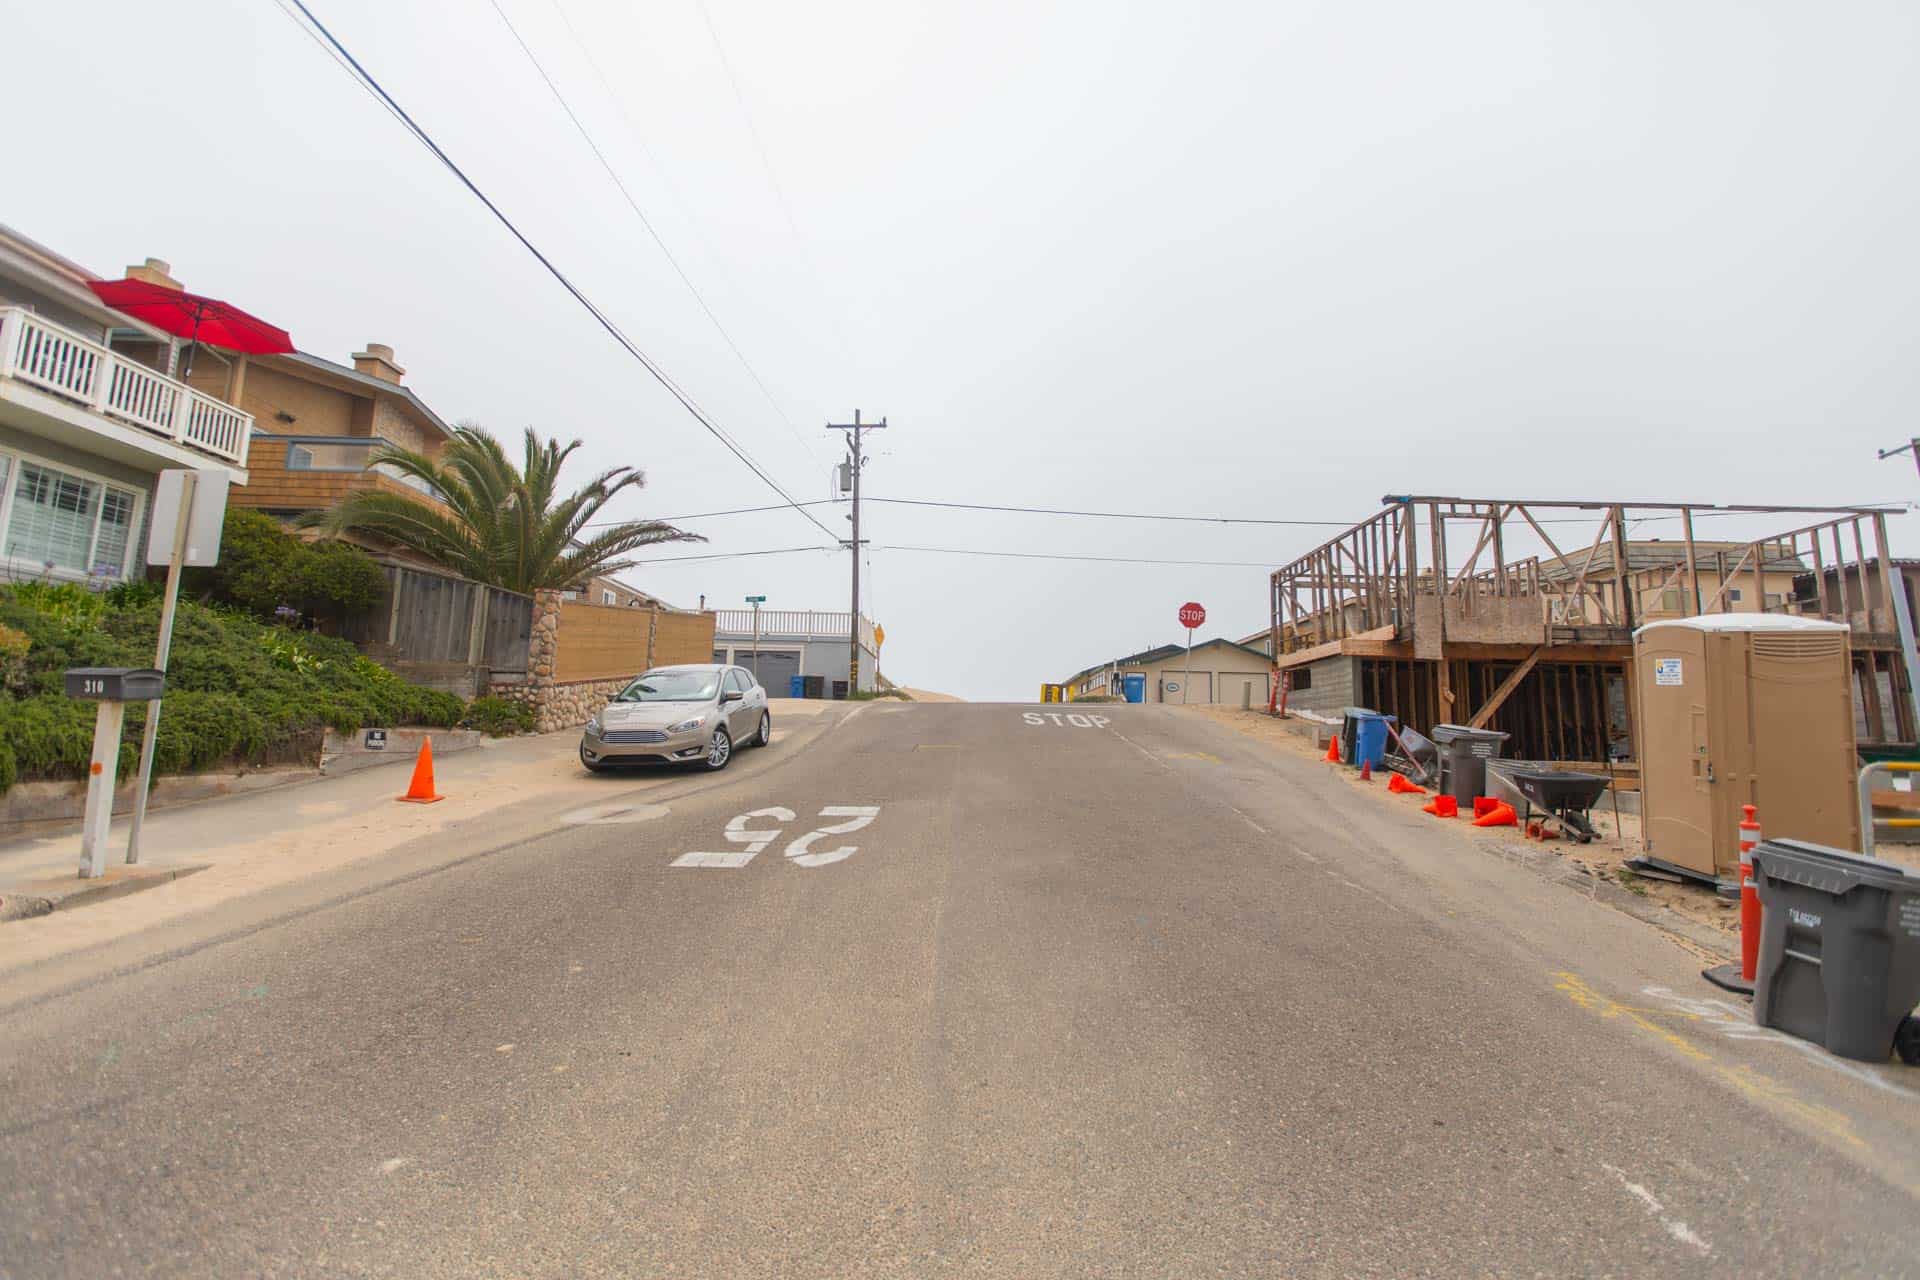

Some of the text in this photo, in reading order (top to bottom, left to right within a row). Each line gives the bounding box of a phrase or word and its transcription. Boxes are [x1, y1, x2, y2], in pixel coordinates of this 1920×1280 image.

[1180, 610, 1205, 621] STOP
[84, 680, 104, 693] 310
[1022, 712, 1111, 728] STOP
[669, 806, 880, 868] 25
